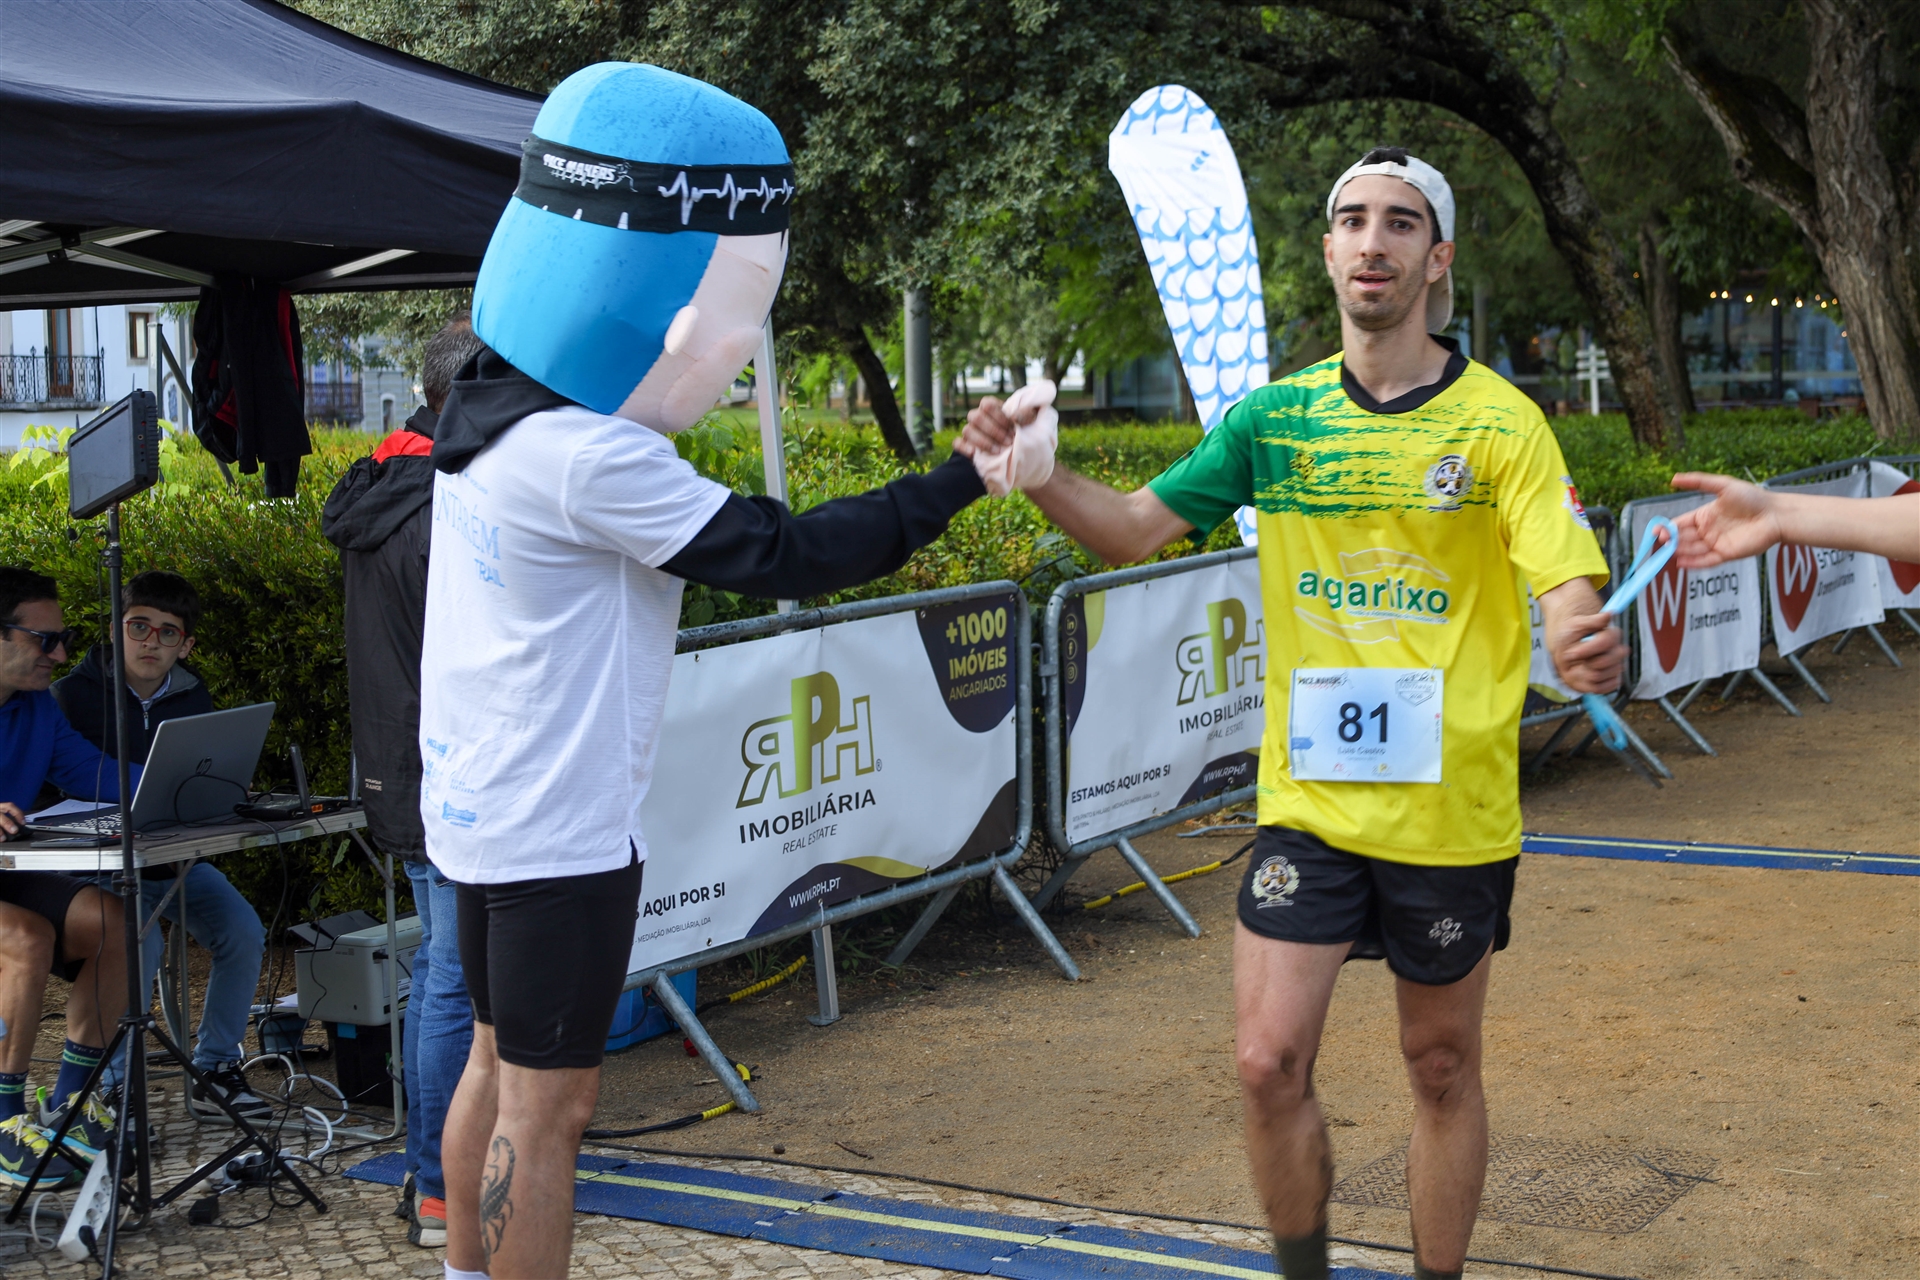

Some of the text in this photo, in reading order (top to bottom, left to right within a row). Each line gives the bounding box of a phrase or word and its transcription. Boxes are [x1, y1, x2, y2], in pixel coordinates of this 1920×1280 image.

[946, 607, 1007, 646] +1000
[949, 646, 1007, 680] IMÓVEIS
[949, 674, 1007, 702] ANGARIADOS
[1206, 719, 1244, 742] REAL ESTATE
[1337, 701, 1389, 743] 81
[1071, 764, 1171, 804] ESTAMOS AQUI POR SI
[739, 789, 876, 844] IMOBILIÁRIA
[782, 824, 838, 855] REAL ESTATE
[643, 894, 676, 918] AQUI
[680, 886, 710, 907] POR
[713, 882, 725, 899] SI
[789, 877, 842, 908] WWW.RPH.PT
[638, 929, 665, 944] MEDIAÇÃO
